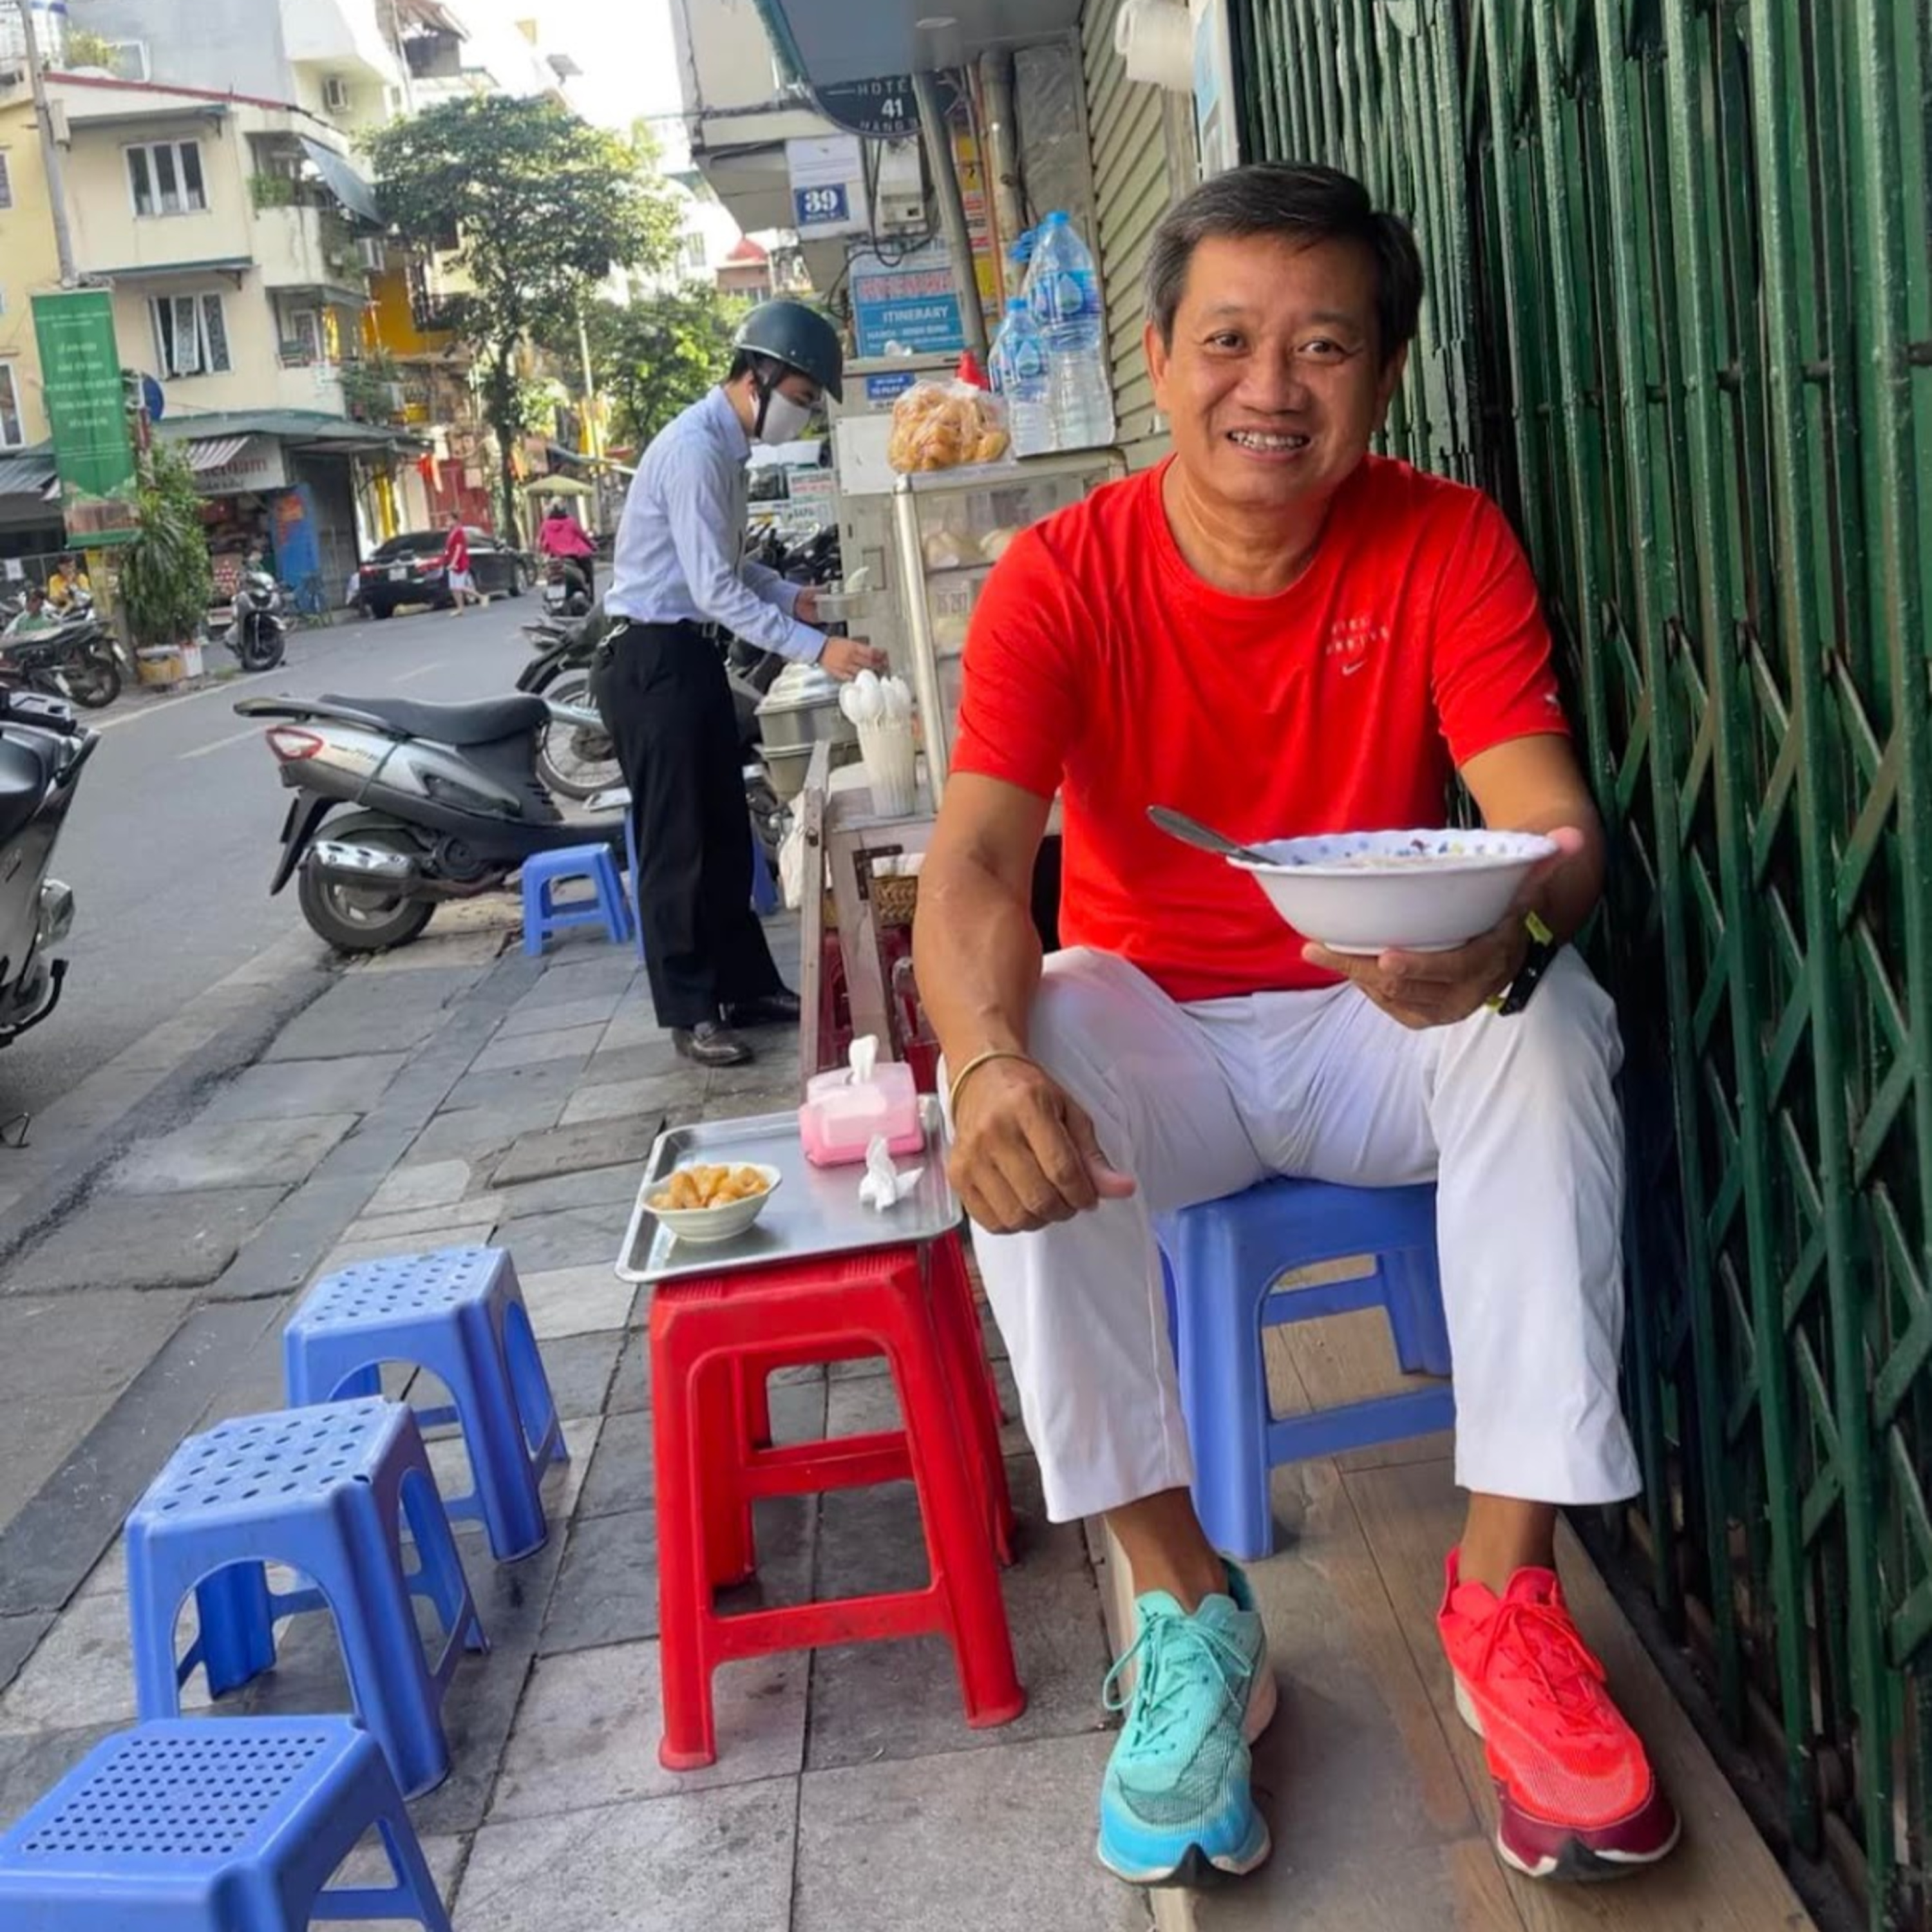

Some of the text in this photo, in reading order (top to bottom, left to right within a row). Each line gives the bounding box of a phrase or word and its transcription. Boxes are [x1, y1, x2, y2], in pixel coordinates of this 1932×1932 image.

[857, 77, 913, 95] HOTE
[881, 98, 903, 118] 41
[804, 189, 838, 213] 39
[883, 305, 949, 323] ITINERARY
